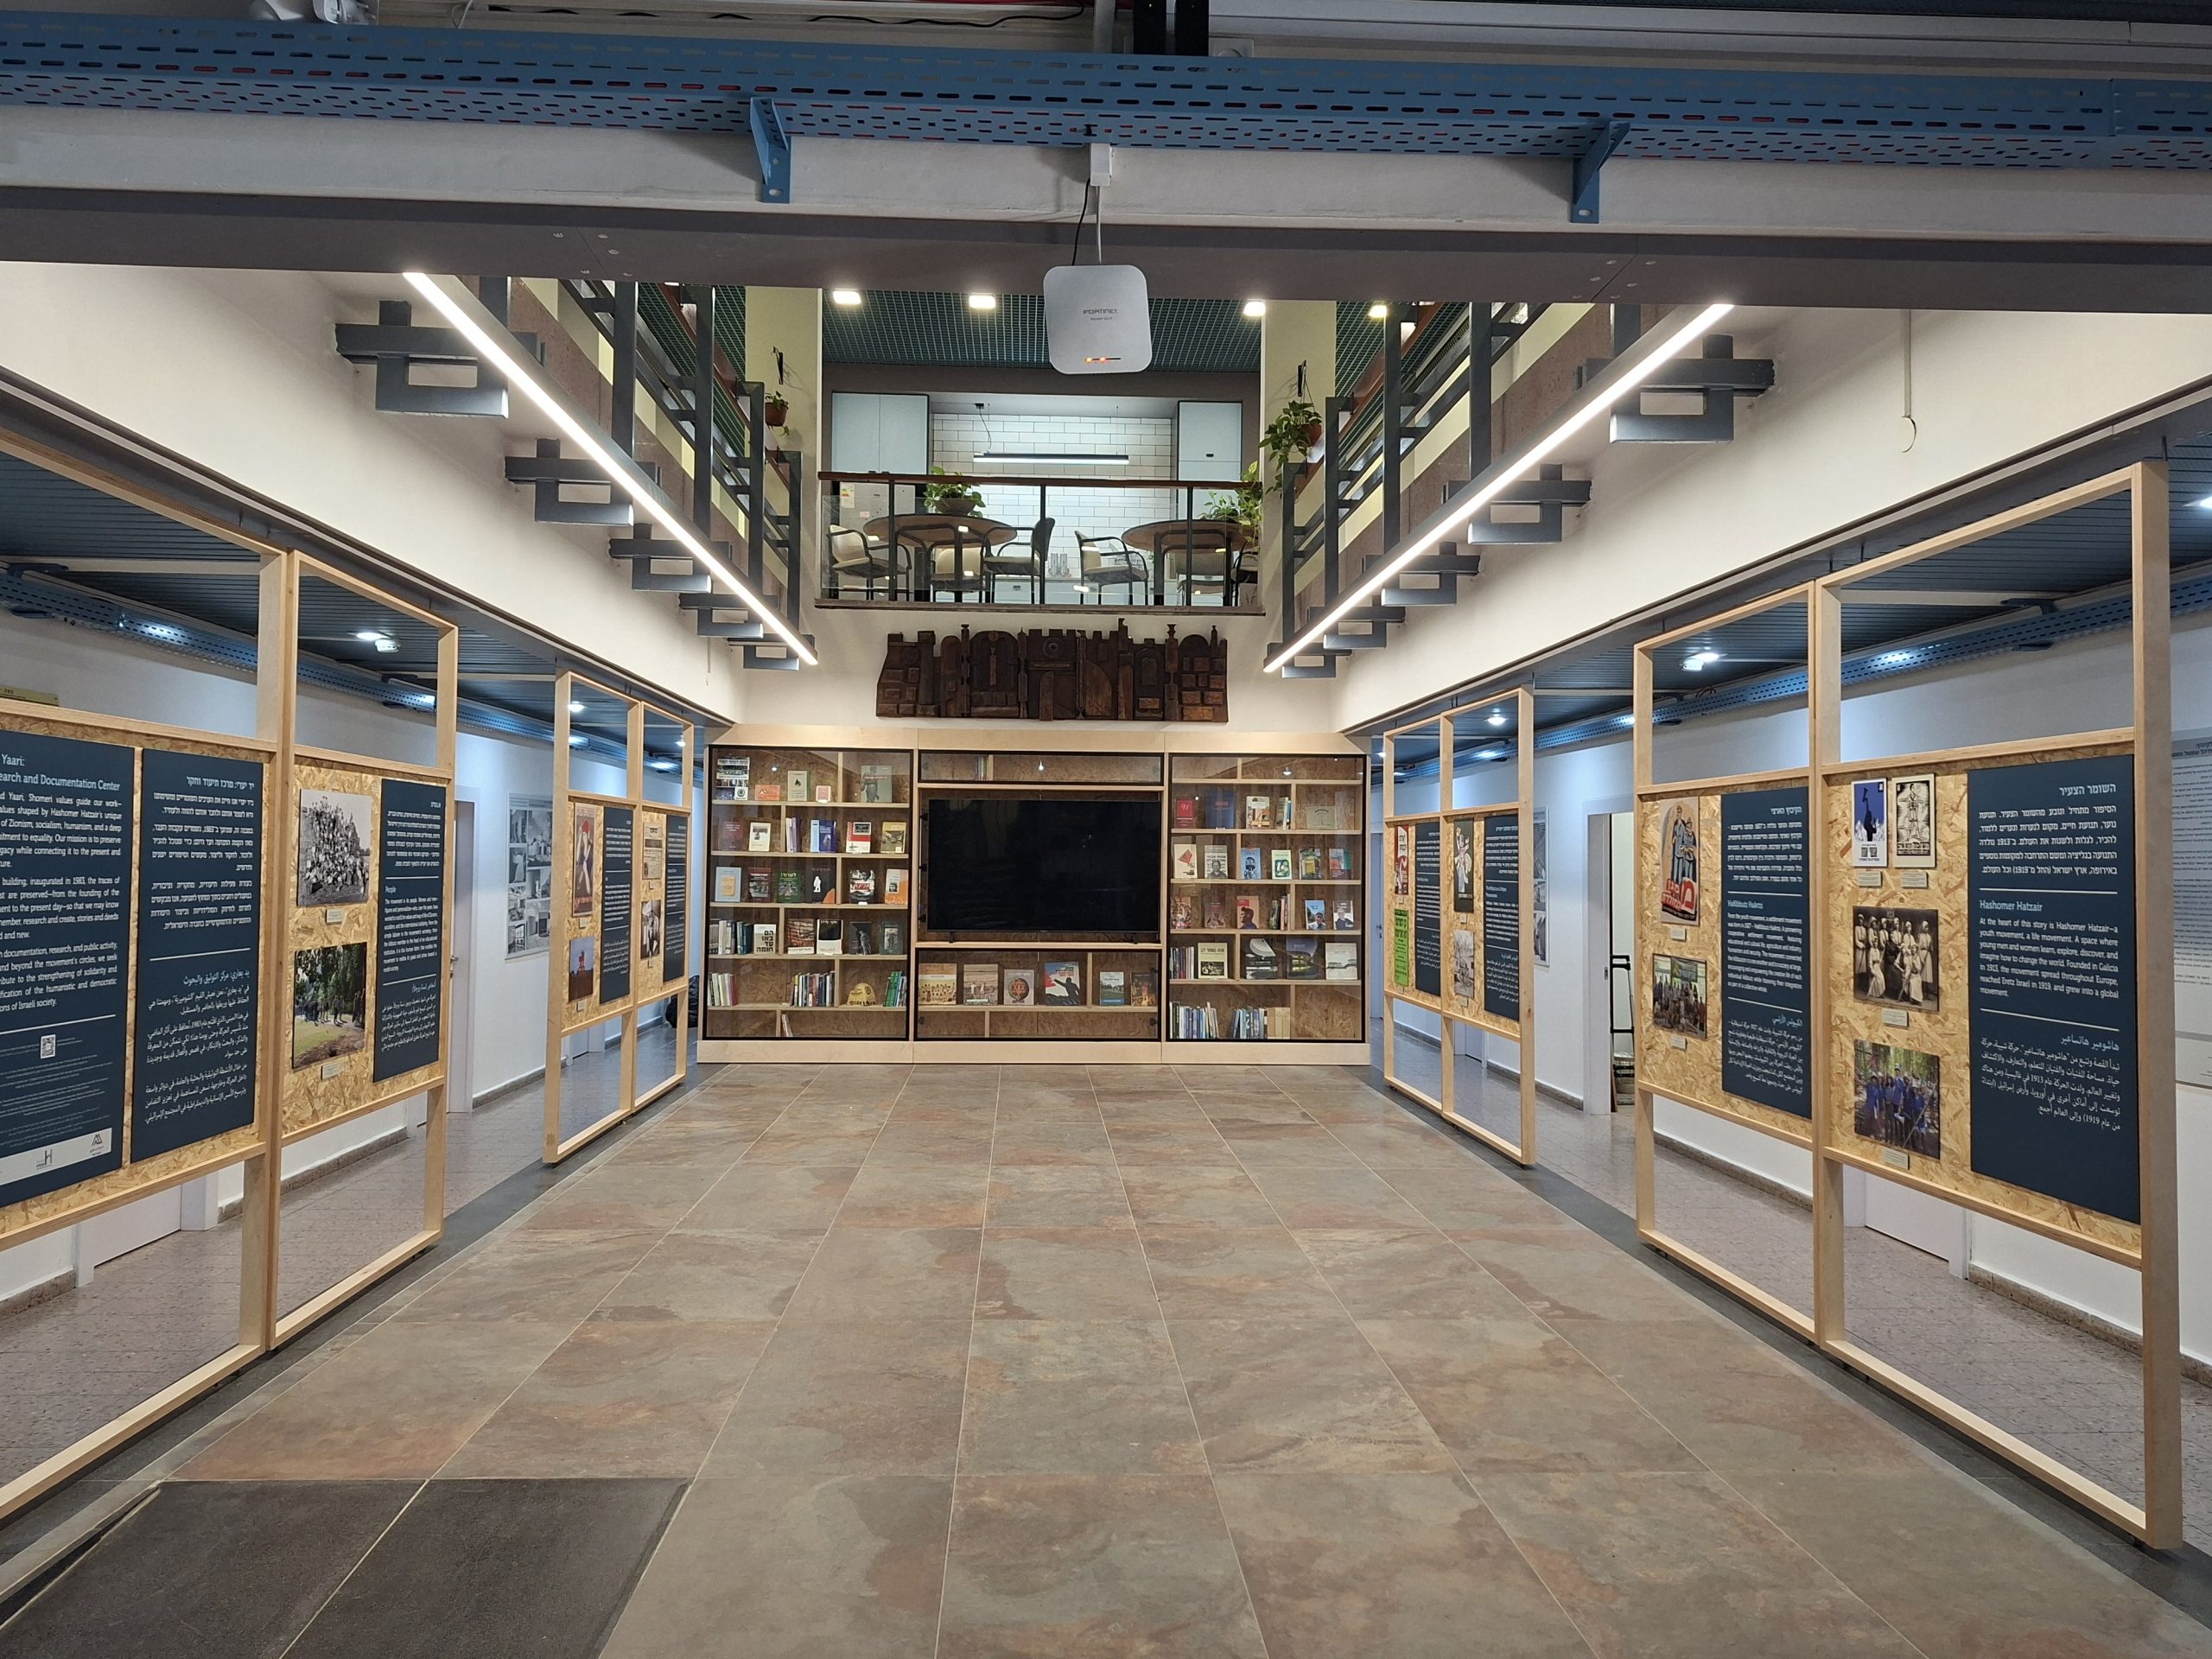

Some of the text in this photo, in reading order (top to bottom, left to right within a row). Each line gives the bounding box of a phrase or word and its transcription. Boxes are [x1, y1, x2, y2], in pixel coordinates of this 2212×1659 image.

[1, 753, 24, 766] Yaari:
[22, 773, 38, 784] and
[40, 773, 97, 789] Documentation
[98, 779, 120, 791] Center
[2059, 784, 2116, 796] השומר הצעיר
[55, 795, 73, 804] values
[75, 798, 91, 806] guide
[17, 806, 39, 816] shaped
[41, 807, 48, 817] by
[50, 808, 79, 817] Hashomer
[0, 818, 7, 827] of
[8, 818, 34, 829] Zionism,
[35, 820, 62, 830] socialism,
[109, 823, 122, 832] deep
[2042, 823, 2058, 831] מקום
[54, 833, 66, 842] Our
[16, 845, 32, 854] while
[34, 848, 66, 856] connecting
[80, 847, 89, 855] the
[2052, 865, 2087, 875] ארץ ישראל
[2, 877, 28, 887] building,
[29, 876, 63, 887] inaugurated
[79, 888, 101, 898] founding
[30, 904, 51, 912] present
[1980, 899, 2043, 912] Hashomer Hatzair
[22, 916, 47, 925] research
[47, 915, 58, 924] and
[93, 912, 104, 921] and
[1997, 918, 2012, 926] heart
[2032, 921, 2047, 930] story
[2056, 921, 2086, 931] Hashomer
[3, 931, 16, 939] and
[1979, 929, 1995, 938] youth
[2031, 931, 2040, 940] life
[2081, 937, 2098, 945] space
[2099, 937, 2118, 946] where
[73, 944, 83, 952] and
[83, 942, 99, 952] public
[2106, 950, 2118, 959] and
[10, 960, 32, 971] beyond
[106, 952, 118, 961] seek
[1999, 953, 2012, 962] how
[2018, 955, 2037, 966] change
[2066, 959, 2091, 969] Founded
[2098, 962, 2119, 972] Galicia
[37, 970, 74, 982] strengthening
[84, 967, 106, 976] solidarity
[107, 964, 118, 973] and
[2011, 968, 2039, 976] movement
[2040, 970, 2060, 979] spread
[2061, 972, 2094, 982] throughout
[24, 987, 31, 995] of
[46, 983, 75, 993] humanistic
[77, 980, 87, 988] and
[89, 978, 118, 988] democratic
[2100, 988, 2119, 998] global
[10, 998, 56, 1010] of Israeli society.
